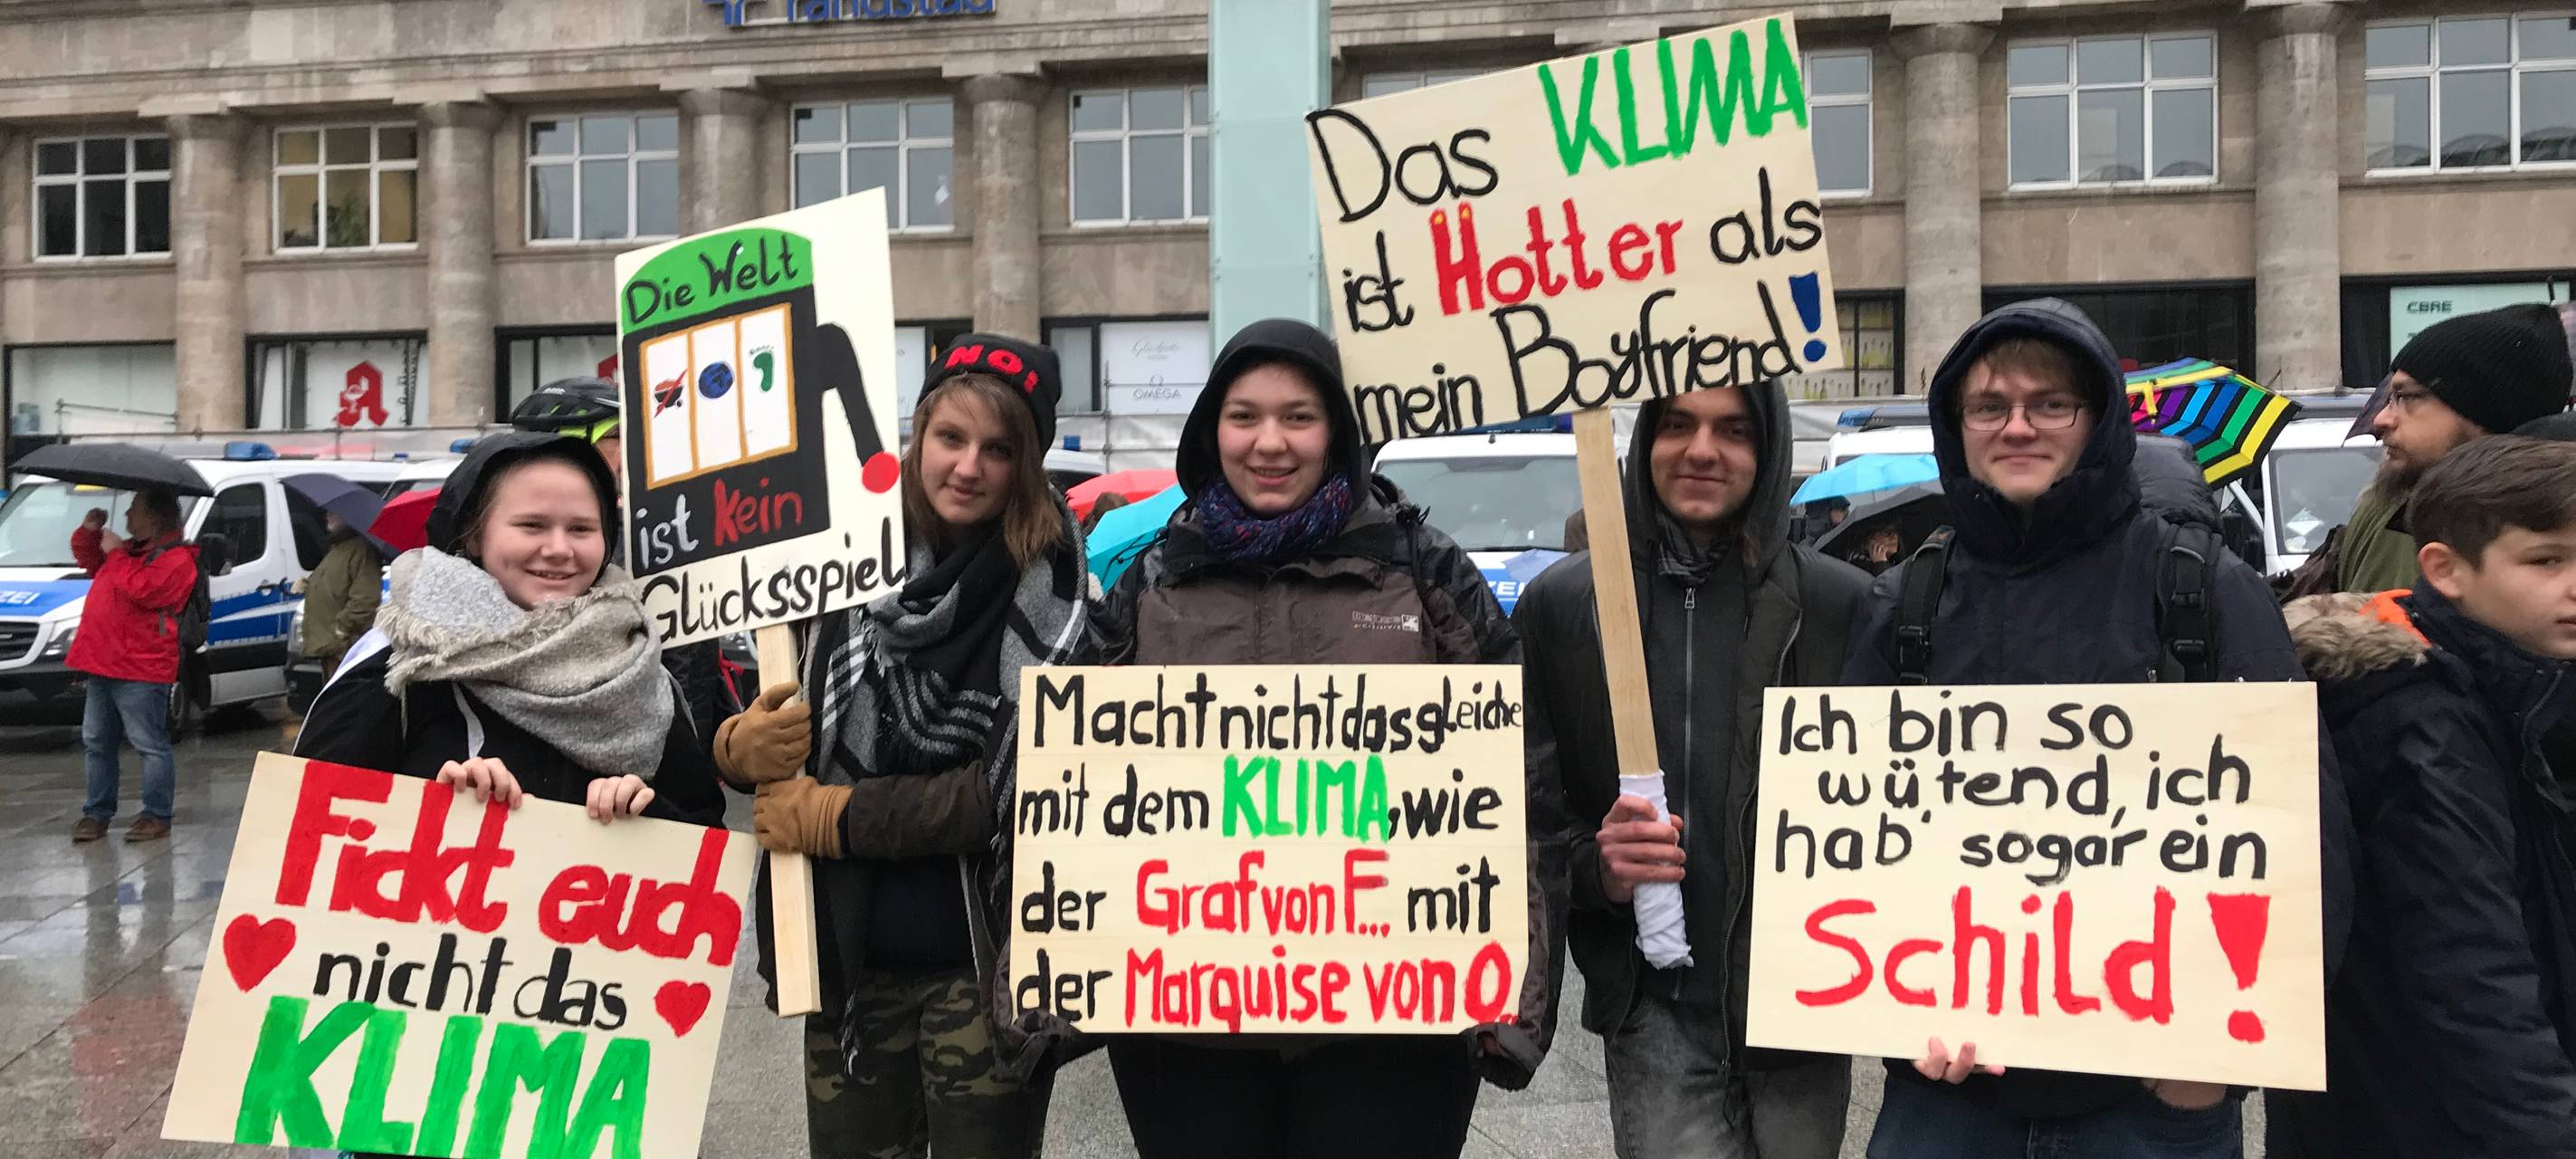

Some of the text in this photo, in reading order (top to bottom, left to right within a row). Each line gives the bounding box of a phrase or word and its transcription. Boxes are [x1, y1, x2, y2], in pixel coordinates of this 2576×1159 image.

[1305, 17, 1808, 223] Das KLIMA
[626, 235, 798, 324] Die Welt
[1342, 166, 1823, 332] ist Hotter als
[2408, 301, 2453, 313] CBRE
[944, 344, 1040, 393] NO!
[1133, 388, 1181, 399] OMEGA
[1354, 271, 1827, 445] mein Boyfriend!
[635, 477, 803, 570] ist kein
[641, 515, 906, 644] Glücksspiel
[1034, 672, 1522, 754] Macht nicht das gleiche
[1779, 688, 2134, 757] Ich bin so
[1018, 762, 1089, 838] mit
[1102, 763, 1209, 838] dem
[1818, 733, 2253, 828] wütend, ich
[275, 760, 742, 967] Fickt euch
[1021, 848, 1500, 938] der Graf von F... mit
[1960, 828, 2148, 886] sogar
[2159, 814, 2267, 879] ein
[313, 933, 628, 1030] nicht das
[1016, 947, 1113, 1022] der
[1124, 944, 1350, 1033] Marquise
[1363, 958, 1456, 1024] von
[234, 995, 651, 1159] KLIMA
